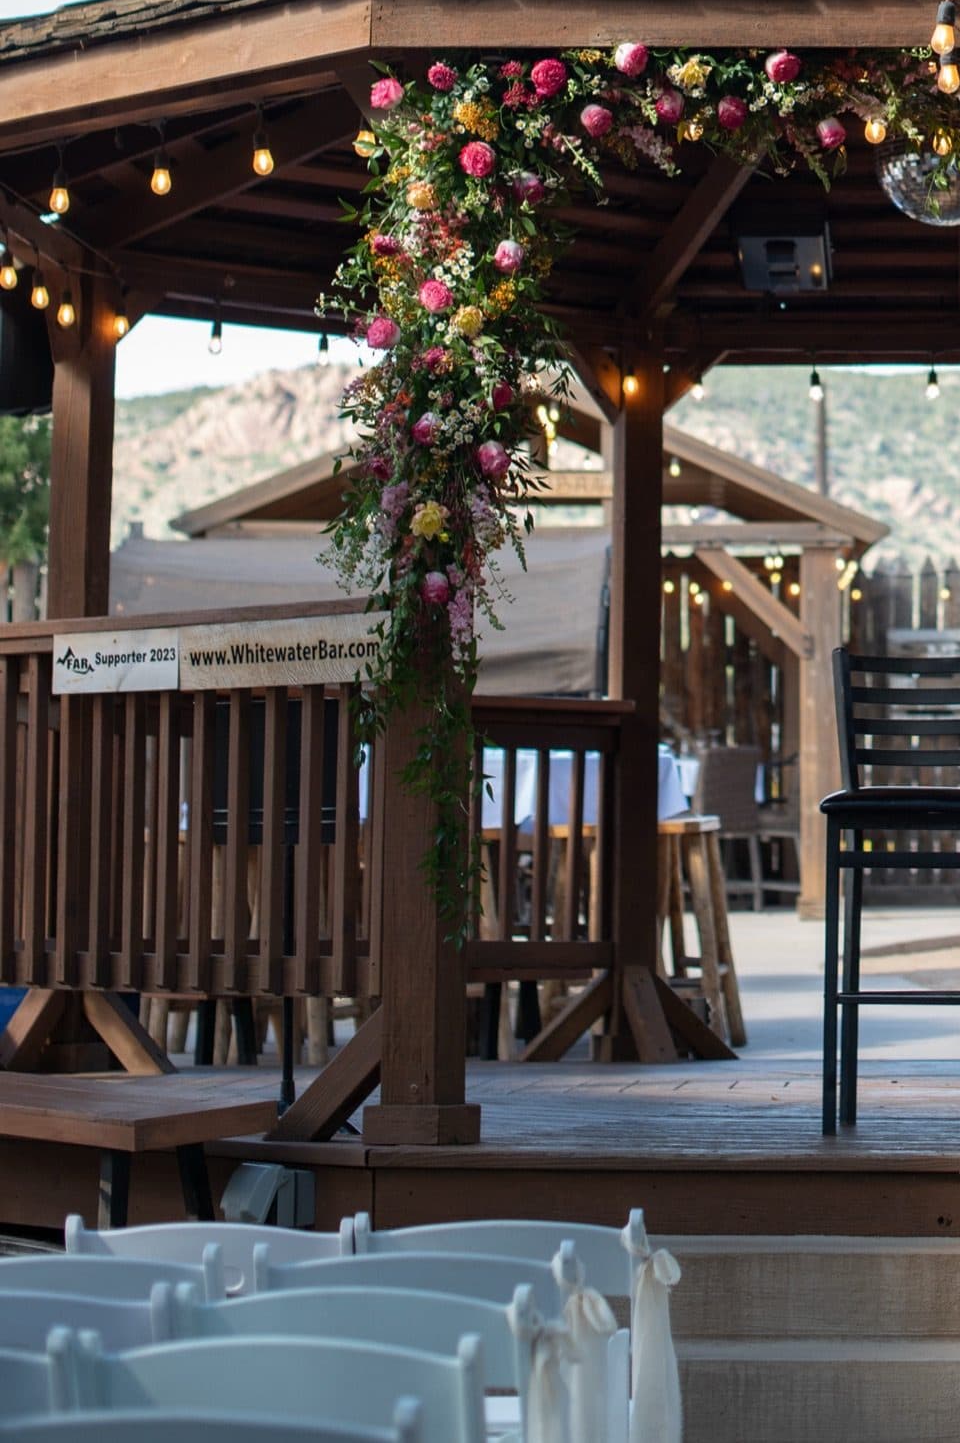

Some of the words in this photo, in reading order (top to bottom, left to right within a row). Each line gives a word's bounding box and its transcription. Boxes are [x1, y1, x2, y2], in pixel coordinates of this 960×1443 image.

[95, 650, 147, 667] Supporter
[150, 647, 176, 662] 2023
[189, 639, 380, 667] www.WhitewaterBar.com
